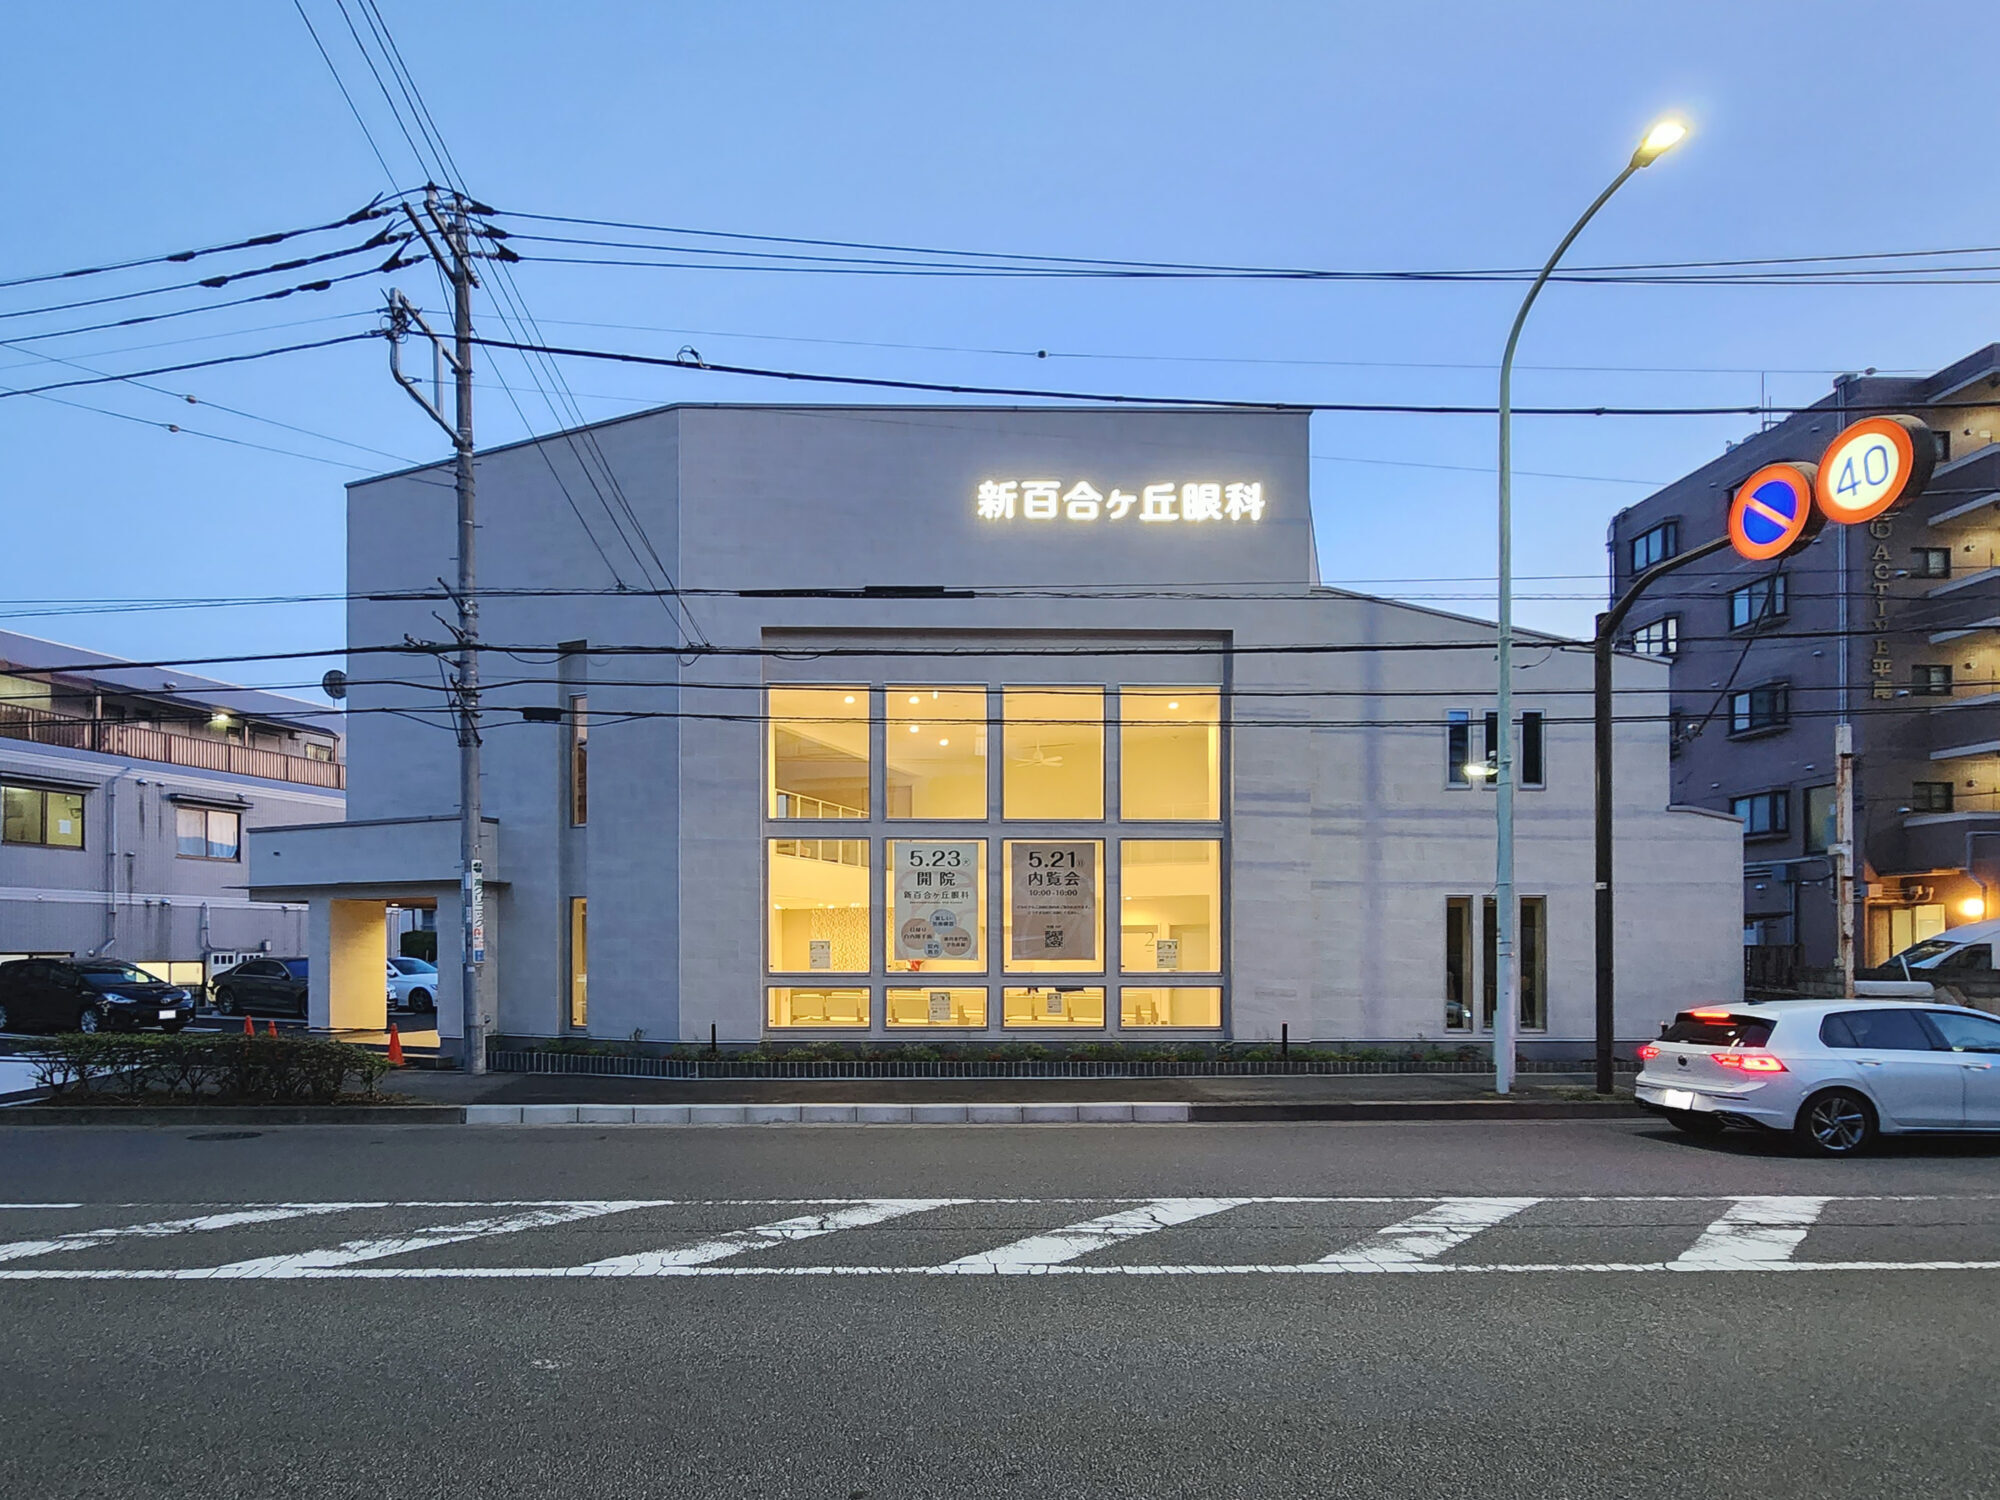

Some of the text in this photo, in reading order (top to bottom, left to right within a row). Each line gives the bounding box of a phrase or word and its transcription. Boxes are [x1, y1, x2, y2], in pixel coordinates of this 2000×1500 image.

[1837, 445, 1889, 496] 40
[977, 480, 1265, 522] 新百合ヶ丘眼科
[909, 850, 961, 867] 5.23
[1028, 851, 1076, 868] 5.21
[917, 871, 956, 887] 開院
[1028, 871, 1080, 887] 内覧会
